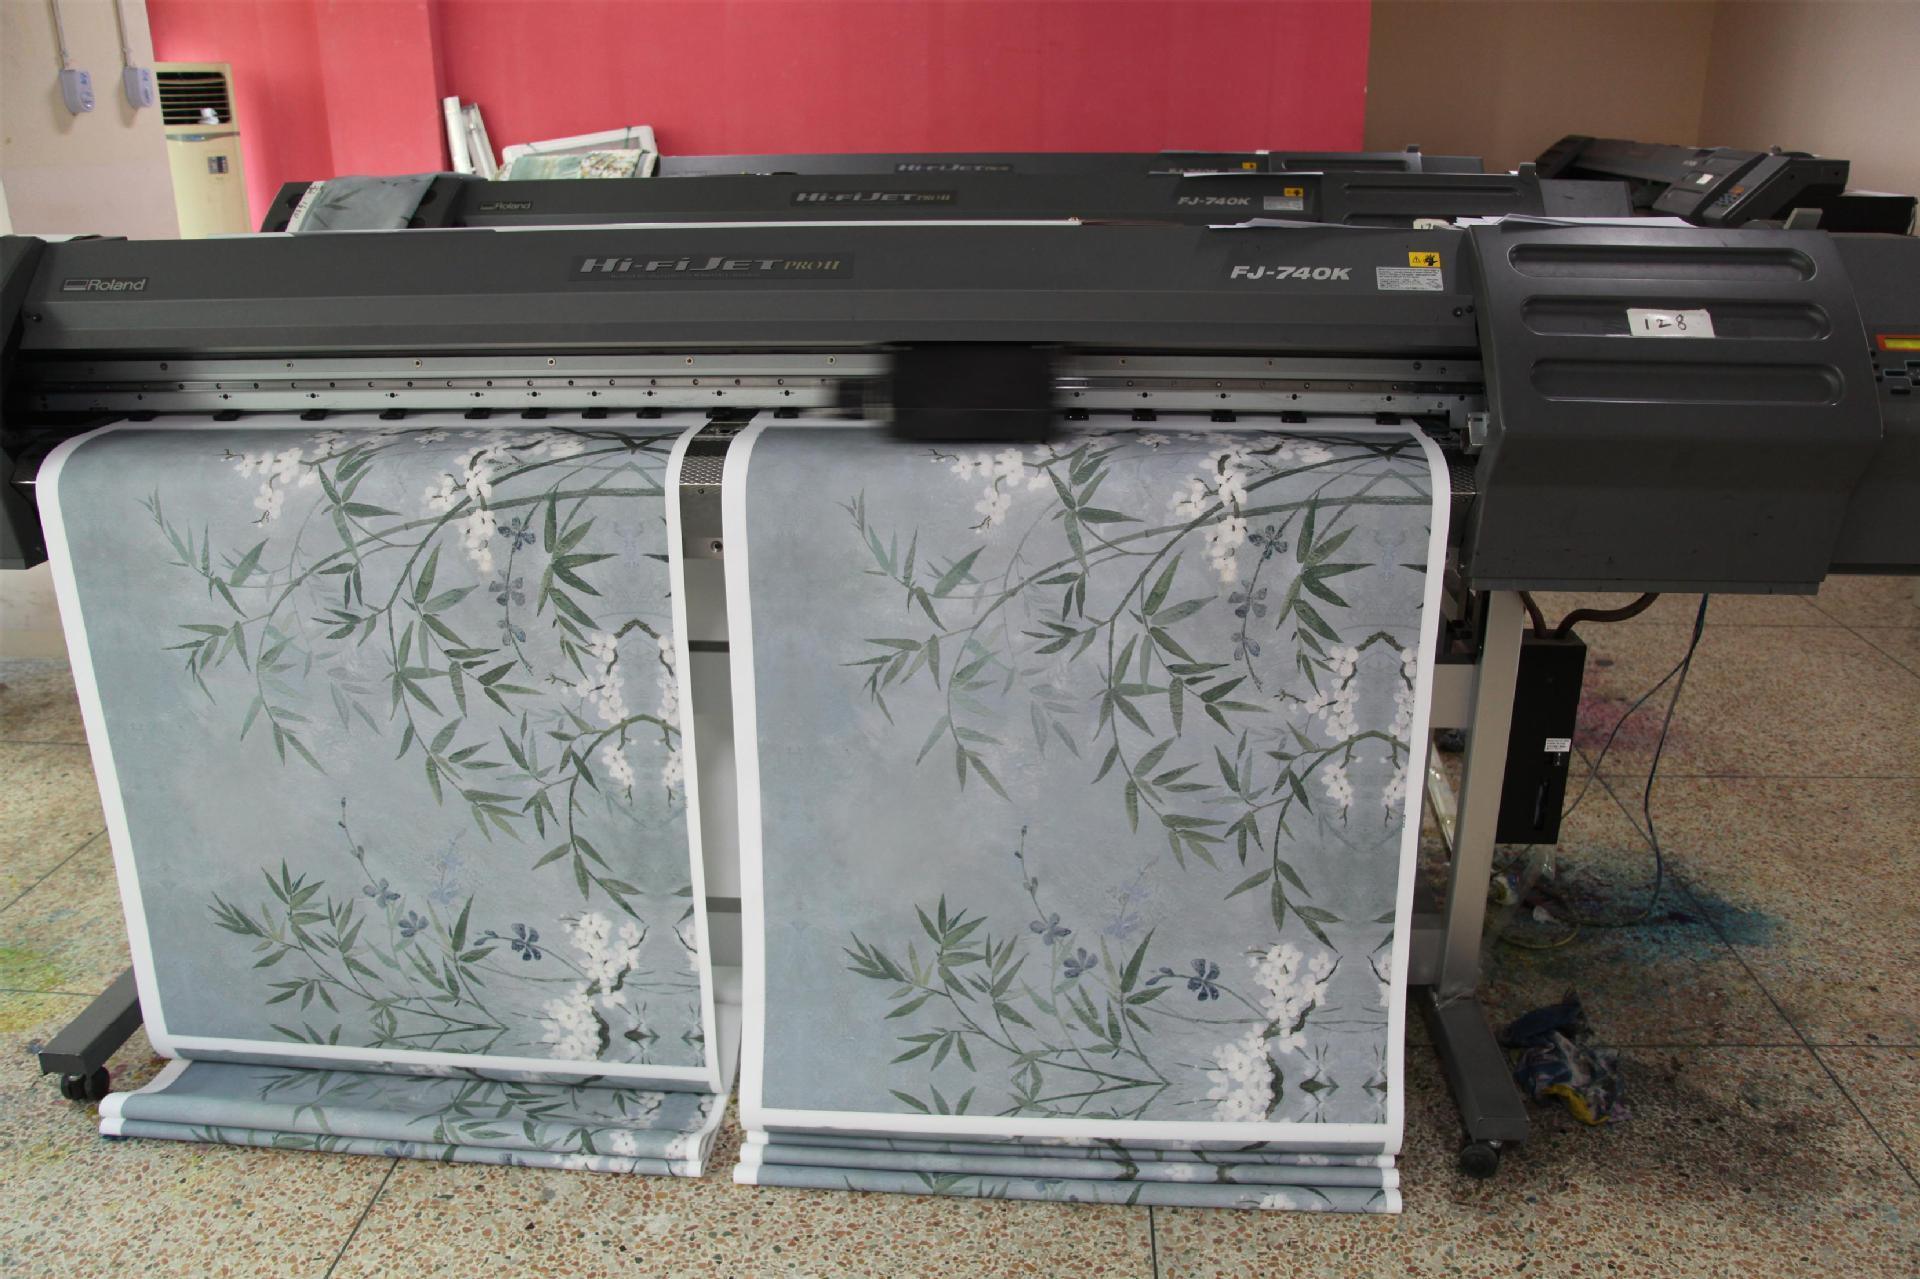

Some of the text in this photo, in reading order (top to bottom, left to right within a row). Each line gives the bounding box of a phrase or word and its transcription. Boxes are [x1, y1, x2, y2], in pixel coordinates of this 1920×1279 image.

[1177, 196, 1250, 206] FJ-740K
[1230, 265, 1352, 280] FJ-740K
[87, 279, 147, 291] Roland
[1644, 314, 1687, 331] 128
